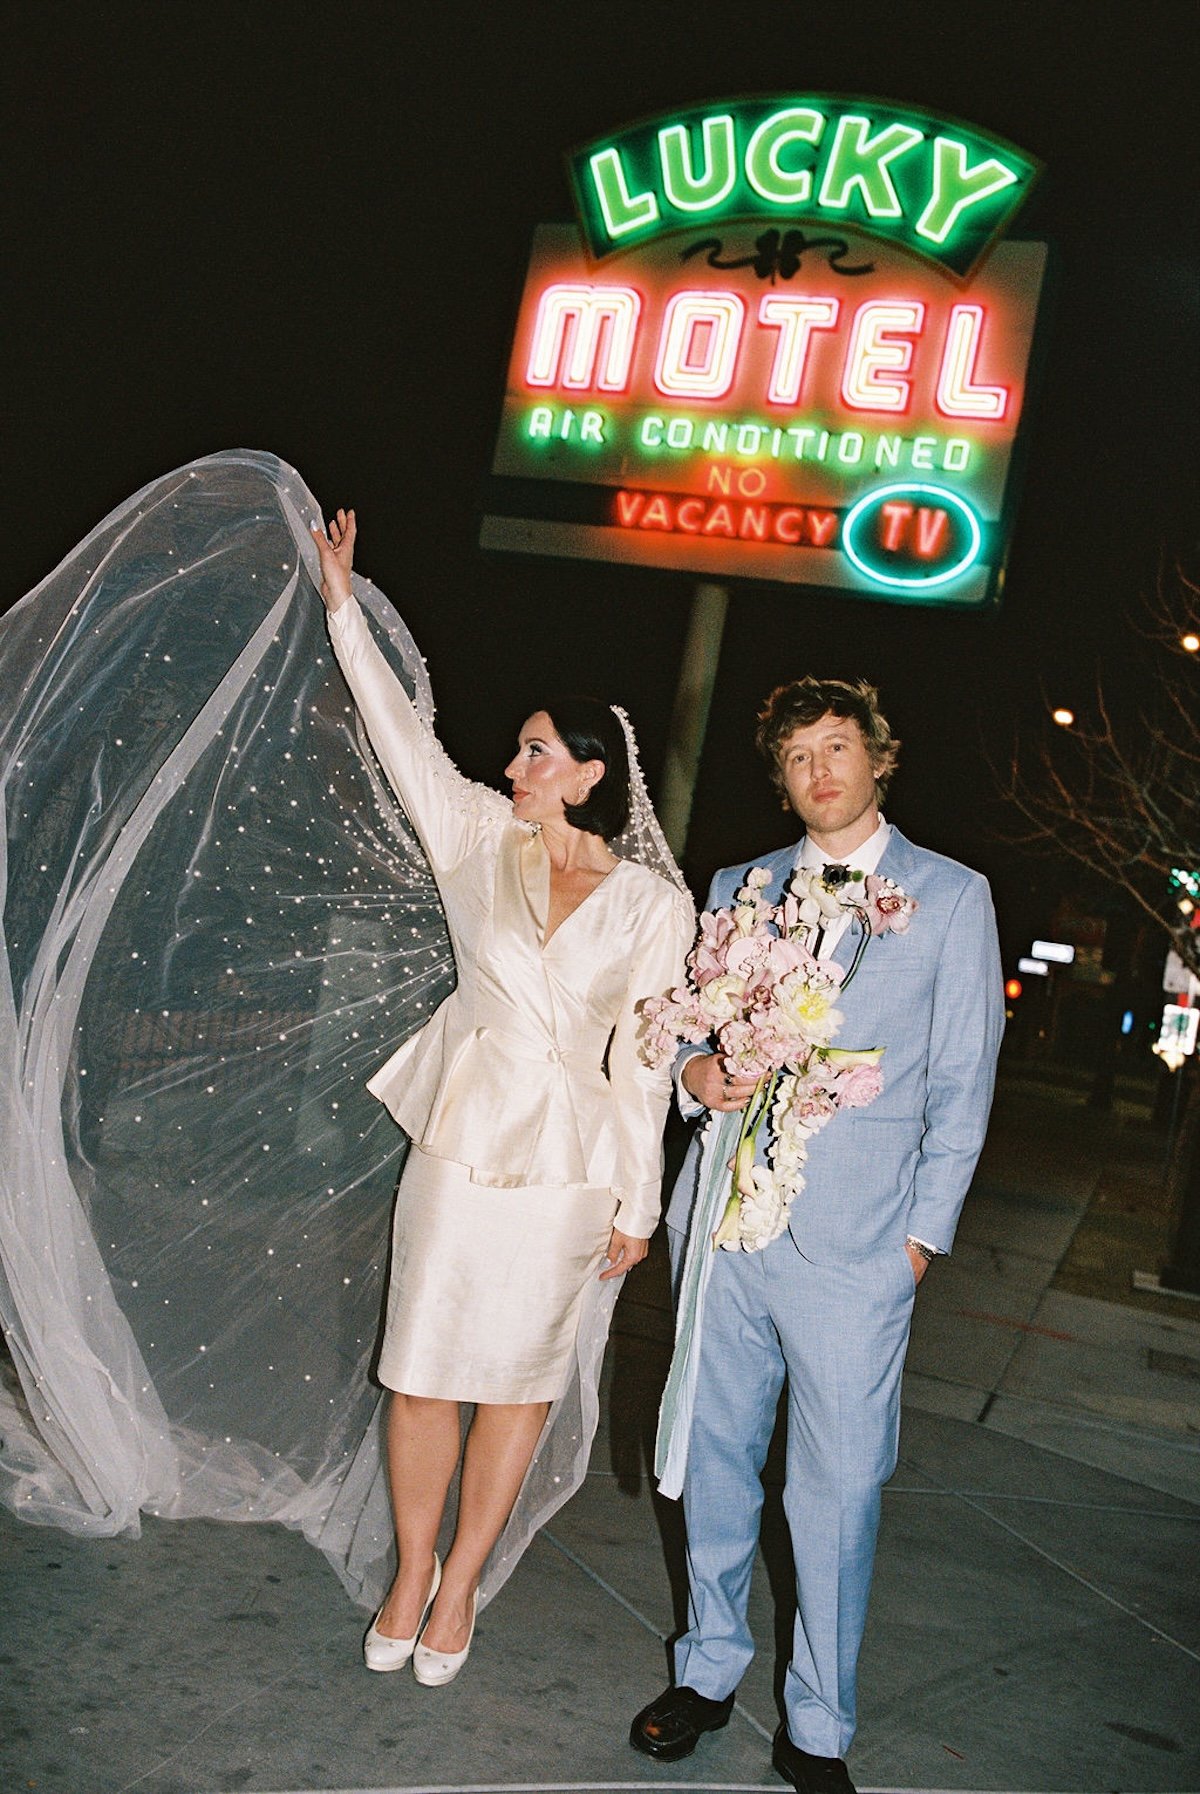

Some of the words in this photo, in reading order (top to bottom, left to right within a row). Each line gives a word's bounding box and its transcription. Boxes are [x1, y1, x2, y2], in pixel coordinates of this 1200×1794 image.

[589, 107, 1018, 243] LUCKY
[526, 284, 1008, 419] MOTEL
[528, 406, 605, 443] AIR
[641, 415, 971, 471] CONDITIONED
[706, 466, 767, 496] NO
[616, 492, 836, 546] VACANCY
[880, 504, 948, 554] TV
